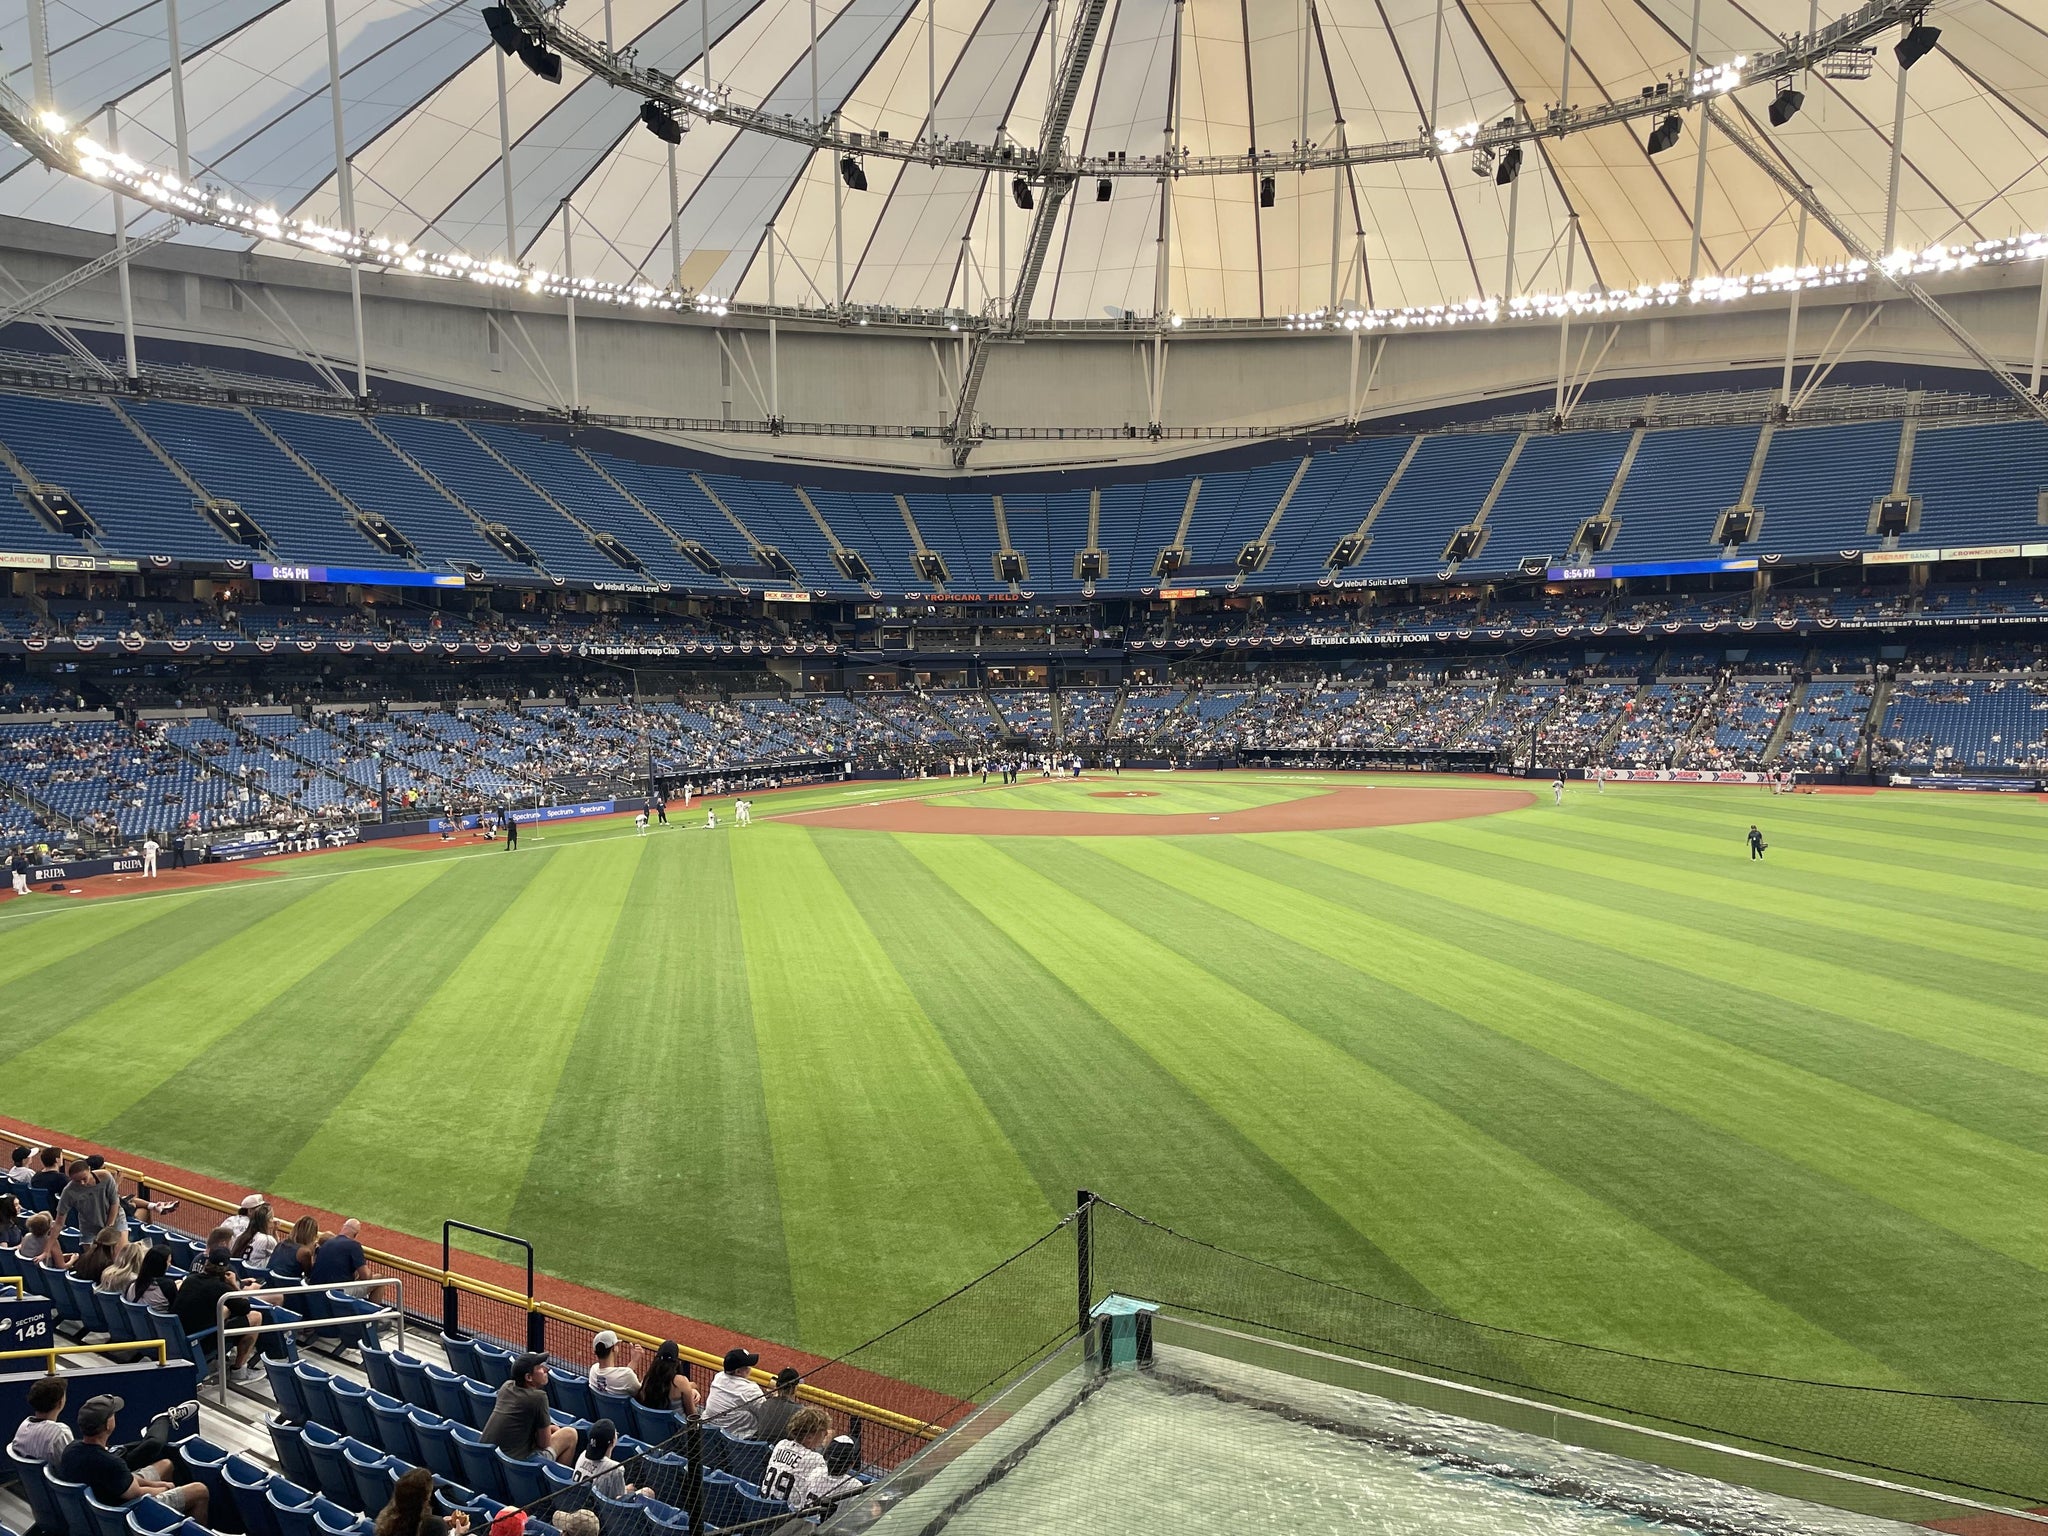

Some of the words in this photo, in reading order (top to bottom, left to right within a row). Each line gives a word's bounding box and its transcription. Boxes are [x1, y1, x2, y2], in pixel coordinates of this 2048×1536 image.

[1910, 552, 1930, 560] BANK
[272, 566, 294, 579] 6:54
[296, 567, 309, 580] PM
[1563, 568, 1582, 580] 6:54
[1583, 567, 1595, 578] PM
[604, 582, 625, 591] Webull
[625, 583, 642, 592] Suite
[643, 584, 660, 593] Level
[1344, 579, 1367, 588] Webull
[1368, 578, 1387, 587] Suite
[1388, 577, 1408, 586] Level
[923, 593, 982, 601] TROPICANA
[988, 593, 1019, 601] FIELD
[1840, 621, 1861, 629] Need
[1862, 619, 1913, 628] Assistance?
[1914, 618, 1933, 627] Text
[1934, 618, 1954, 626] Your
[2000, 616, 2037, 624] Location
[1311, 636, 1348, 646] REPUBLIC
[1349, 635, 1373, 645] BANK
[1374, 635, 1402, 644] DRAFT
[1402, 634, 1430, 643] ROOM
[589, 646, 605, 655] The
[606, 646, 639, 655] Baldwin
[639, 646, 662, 657] Group
[662, 646, 680, 655] Club
[547, 809, 572, 818] Spectrum
[580, 806, 604, 815] Spectrum
[512, 813, 539, 822] Spectrum
[121, 858, 143, 871] RIPA
[43, 867, 66, 880] RIPA
[15, 1313, 45, 1327] SECTION
[15, 1321, 47, 1342] 148
[773, 1448, 803, 1469] JUDGE
[760, 1466, 796, 1501] 99
